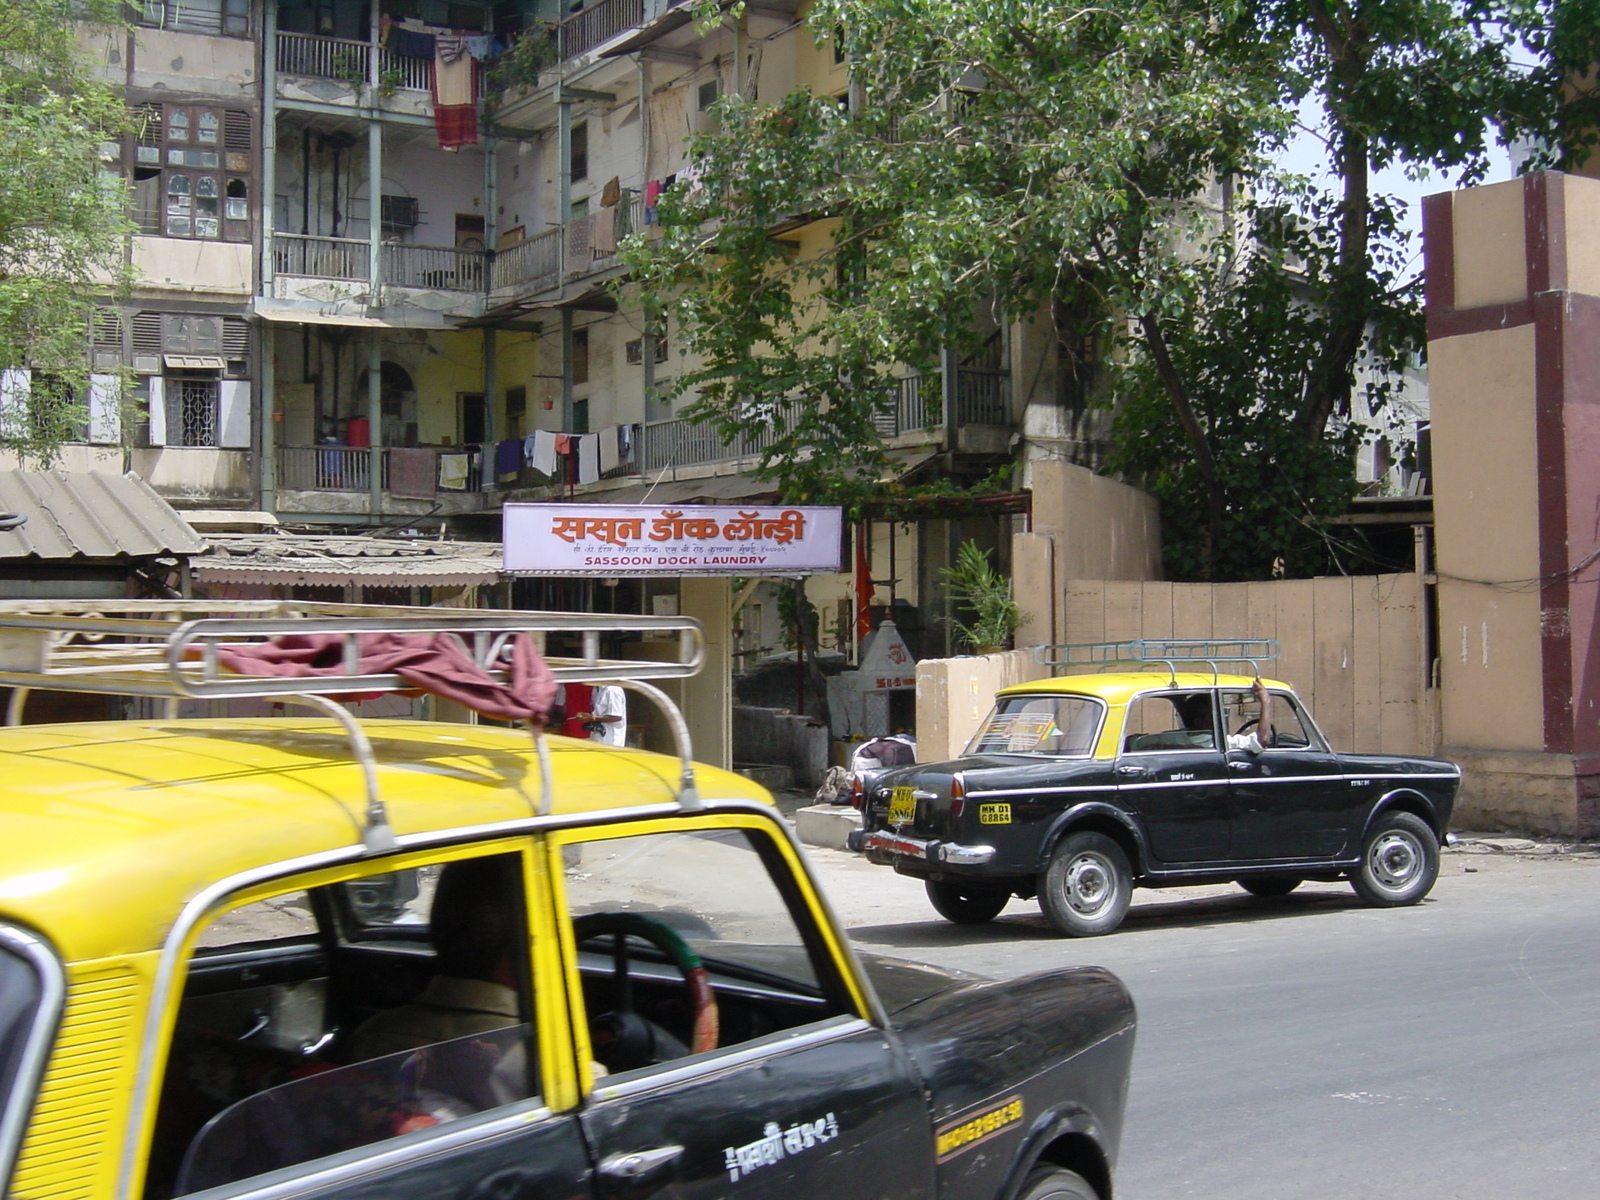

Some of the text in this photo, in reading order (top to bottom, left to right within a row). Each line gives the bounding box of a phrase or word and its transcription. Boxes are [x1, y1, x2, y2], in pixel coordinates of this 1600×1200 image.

[552, 517, 645, 546] ससून
[648, 510, 719, 541] डॉक
[584, 556, 767, 566] SASSOON DOCK LAUNDRY
